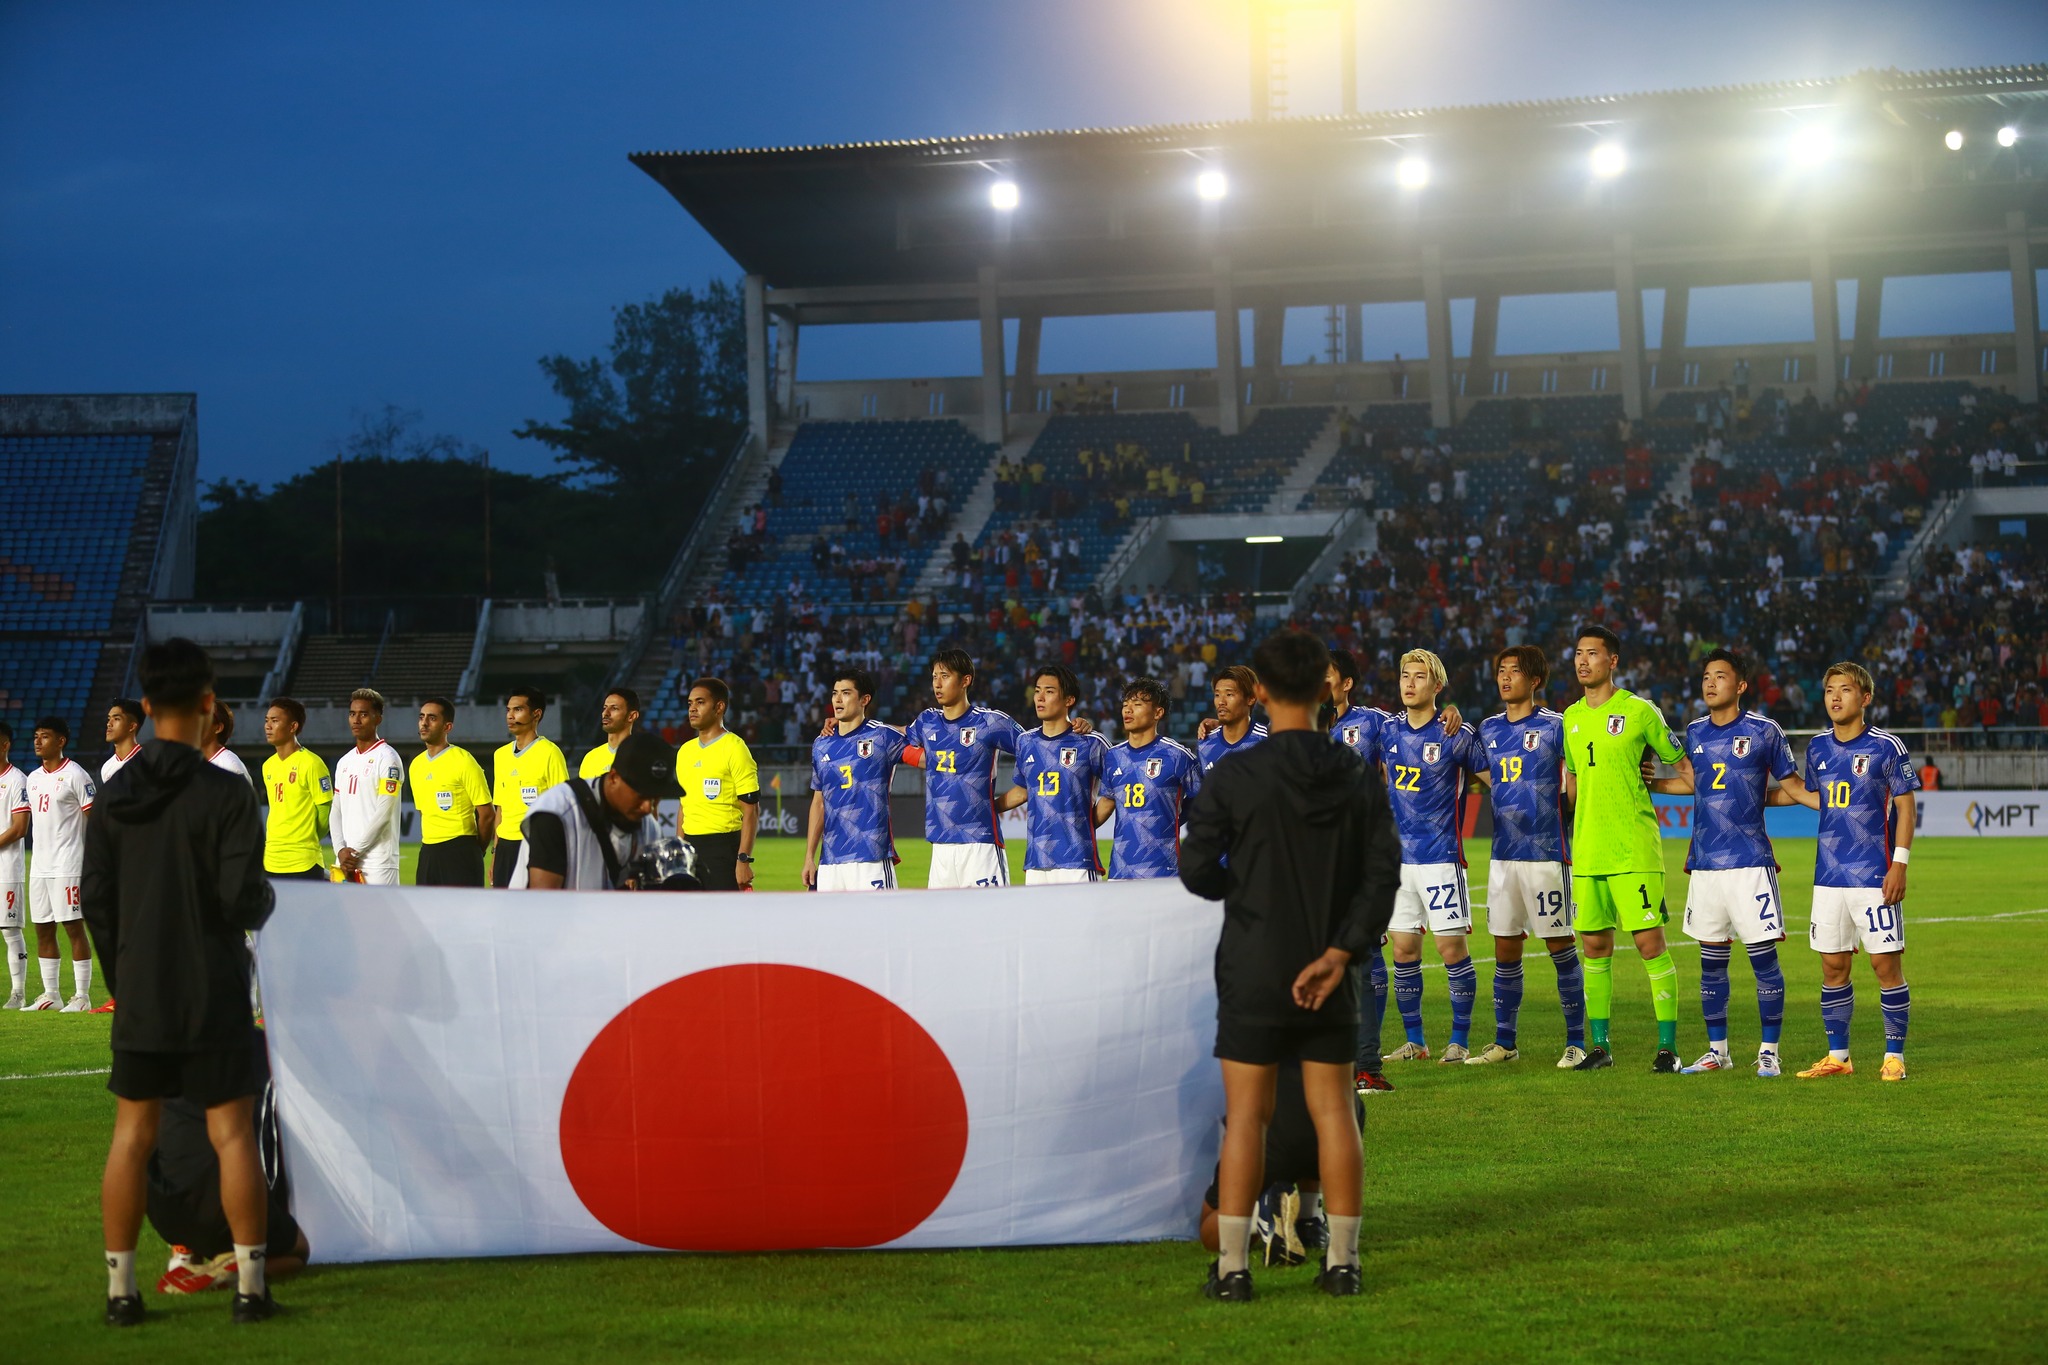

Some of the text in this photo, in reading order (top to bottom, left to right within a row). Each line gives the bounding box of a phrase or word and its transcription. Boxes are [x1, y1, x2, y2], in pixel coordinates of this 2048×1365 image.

[935, 750, 957, 773] 21
[1587, 741, 1596, 767] 1
[839, 765, 853, 790] 3
[1394, 764, 1421, 792] 22
[1499, 757, 1523, 783] 19
[1712, 762, 1726, 790] 2
[274, 783, 283, 803] 18
[348, 774, 358, 795] 11
[1036, 771, 1060, 796] 13
[1123, 783, 1145, 808] 18
[1827, 781, 1850, 808] 10
[38, 793, 50, 813] 13
[1985, 804, 2040, 827] MPT
[757, 807, 798, 834] take
[6, 890, 15, 910] 9
[65, 885, 80, 906] 13
[1426, 883, 1458, 911] 22
[1536, 890, 1563, 917] 19
[1638, 883, 1652, 910] 1
[1755, 892, 1775, 920] 2
[1865, 905, 1894, 934] 10
